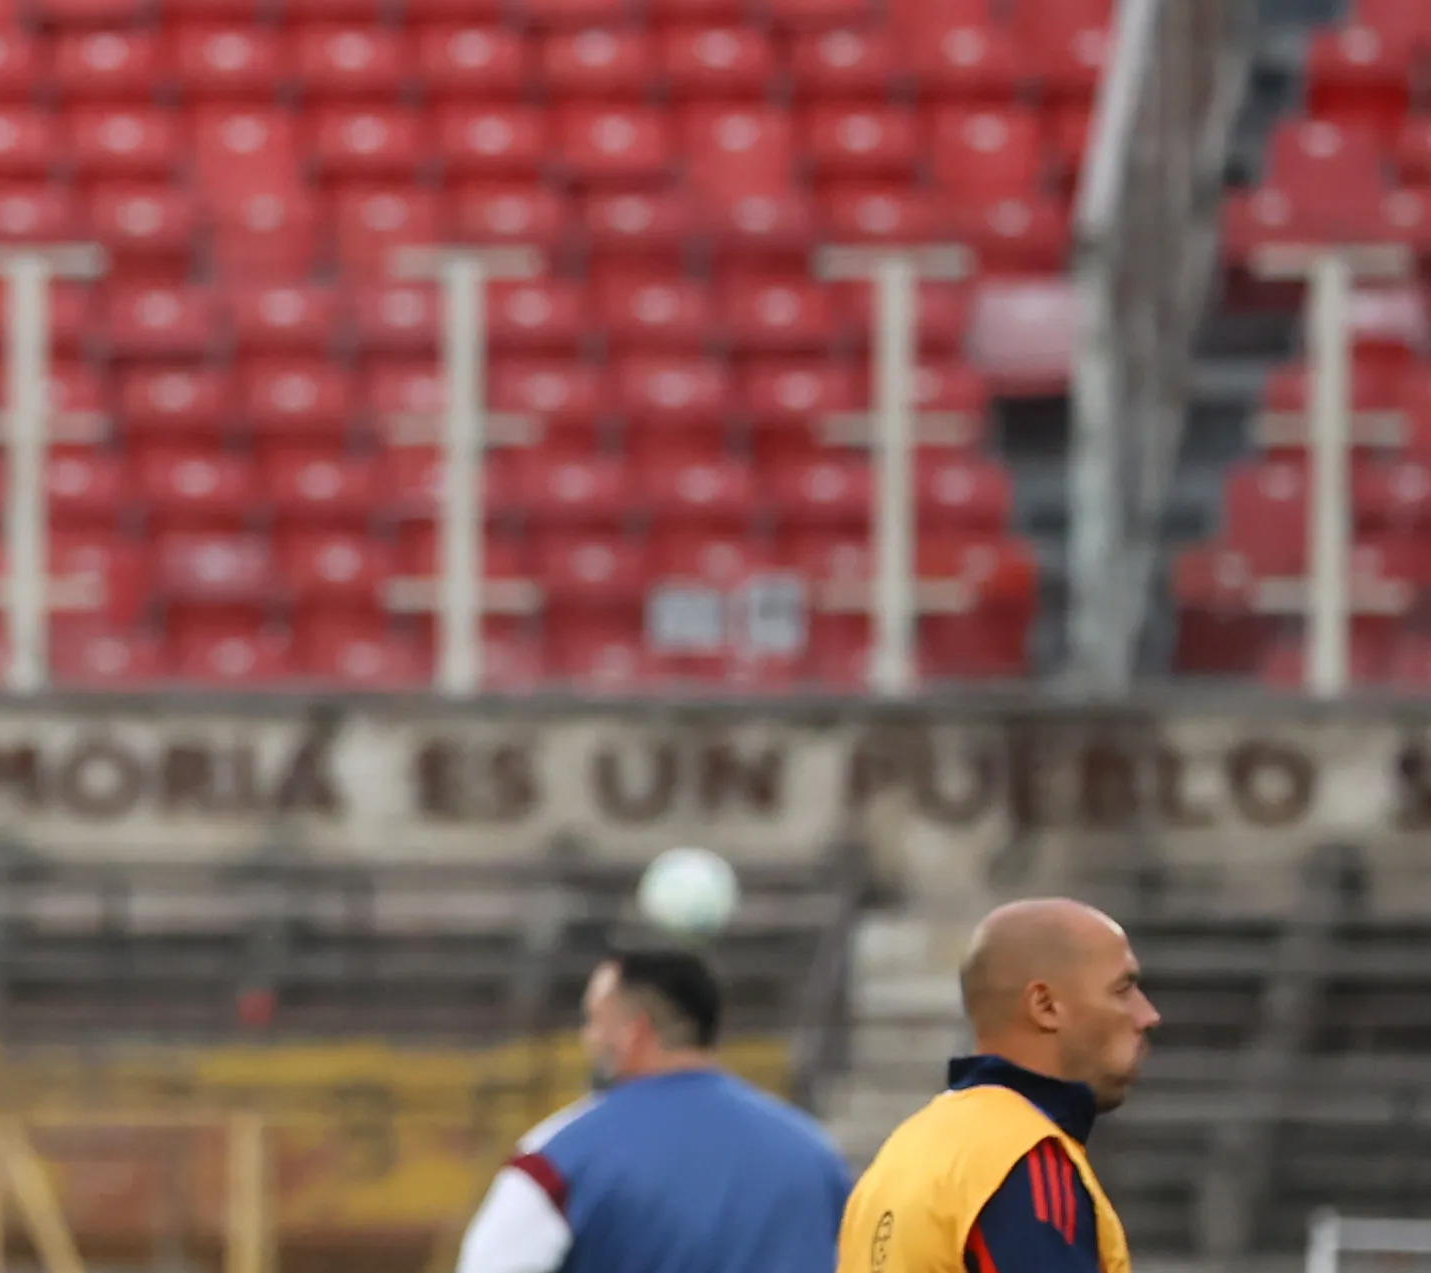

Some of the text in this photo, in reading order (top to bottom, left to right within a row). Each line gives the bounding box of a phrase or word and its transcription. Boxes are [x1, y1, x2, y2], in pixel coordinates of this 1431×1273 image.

[414, 734, 538, 821] ES
[592, 736, 784, 822] UN
[849, 733, 1315, 826] PUEBLO
